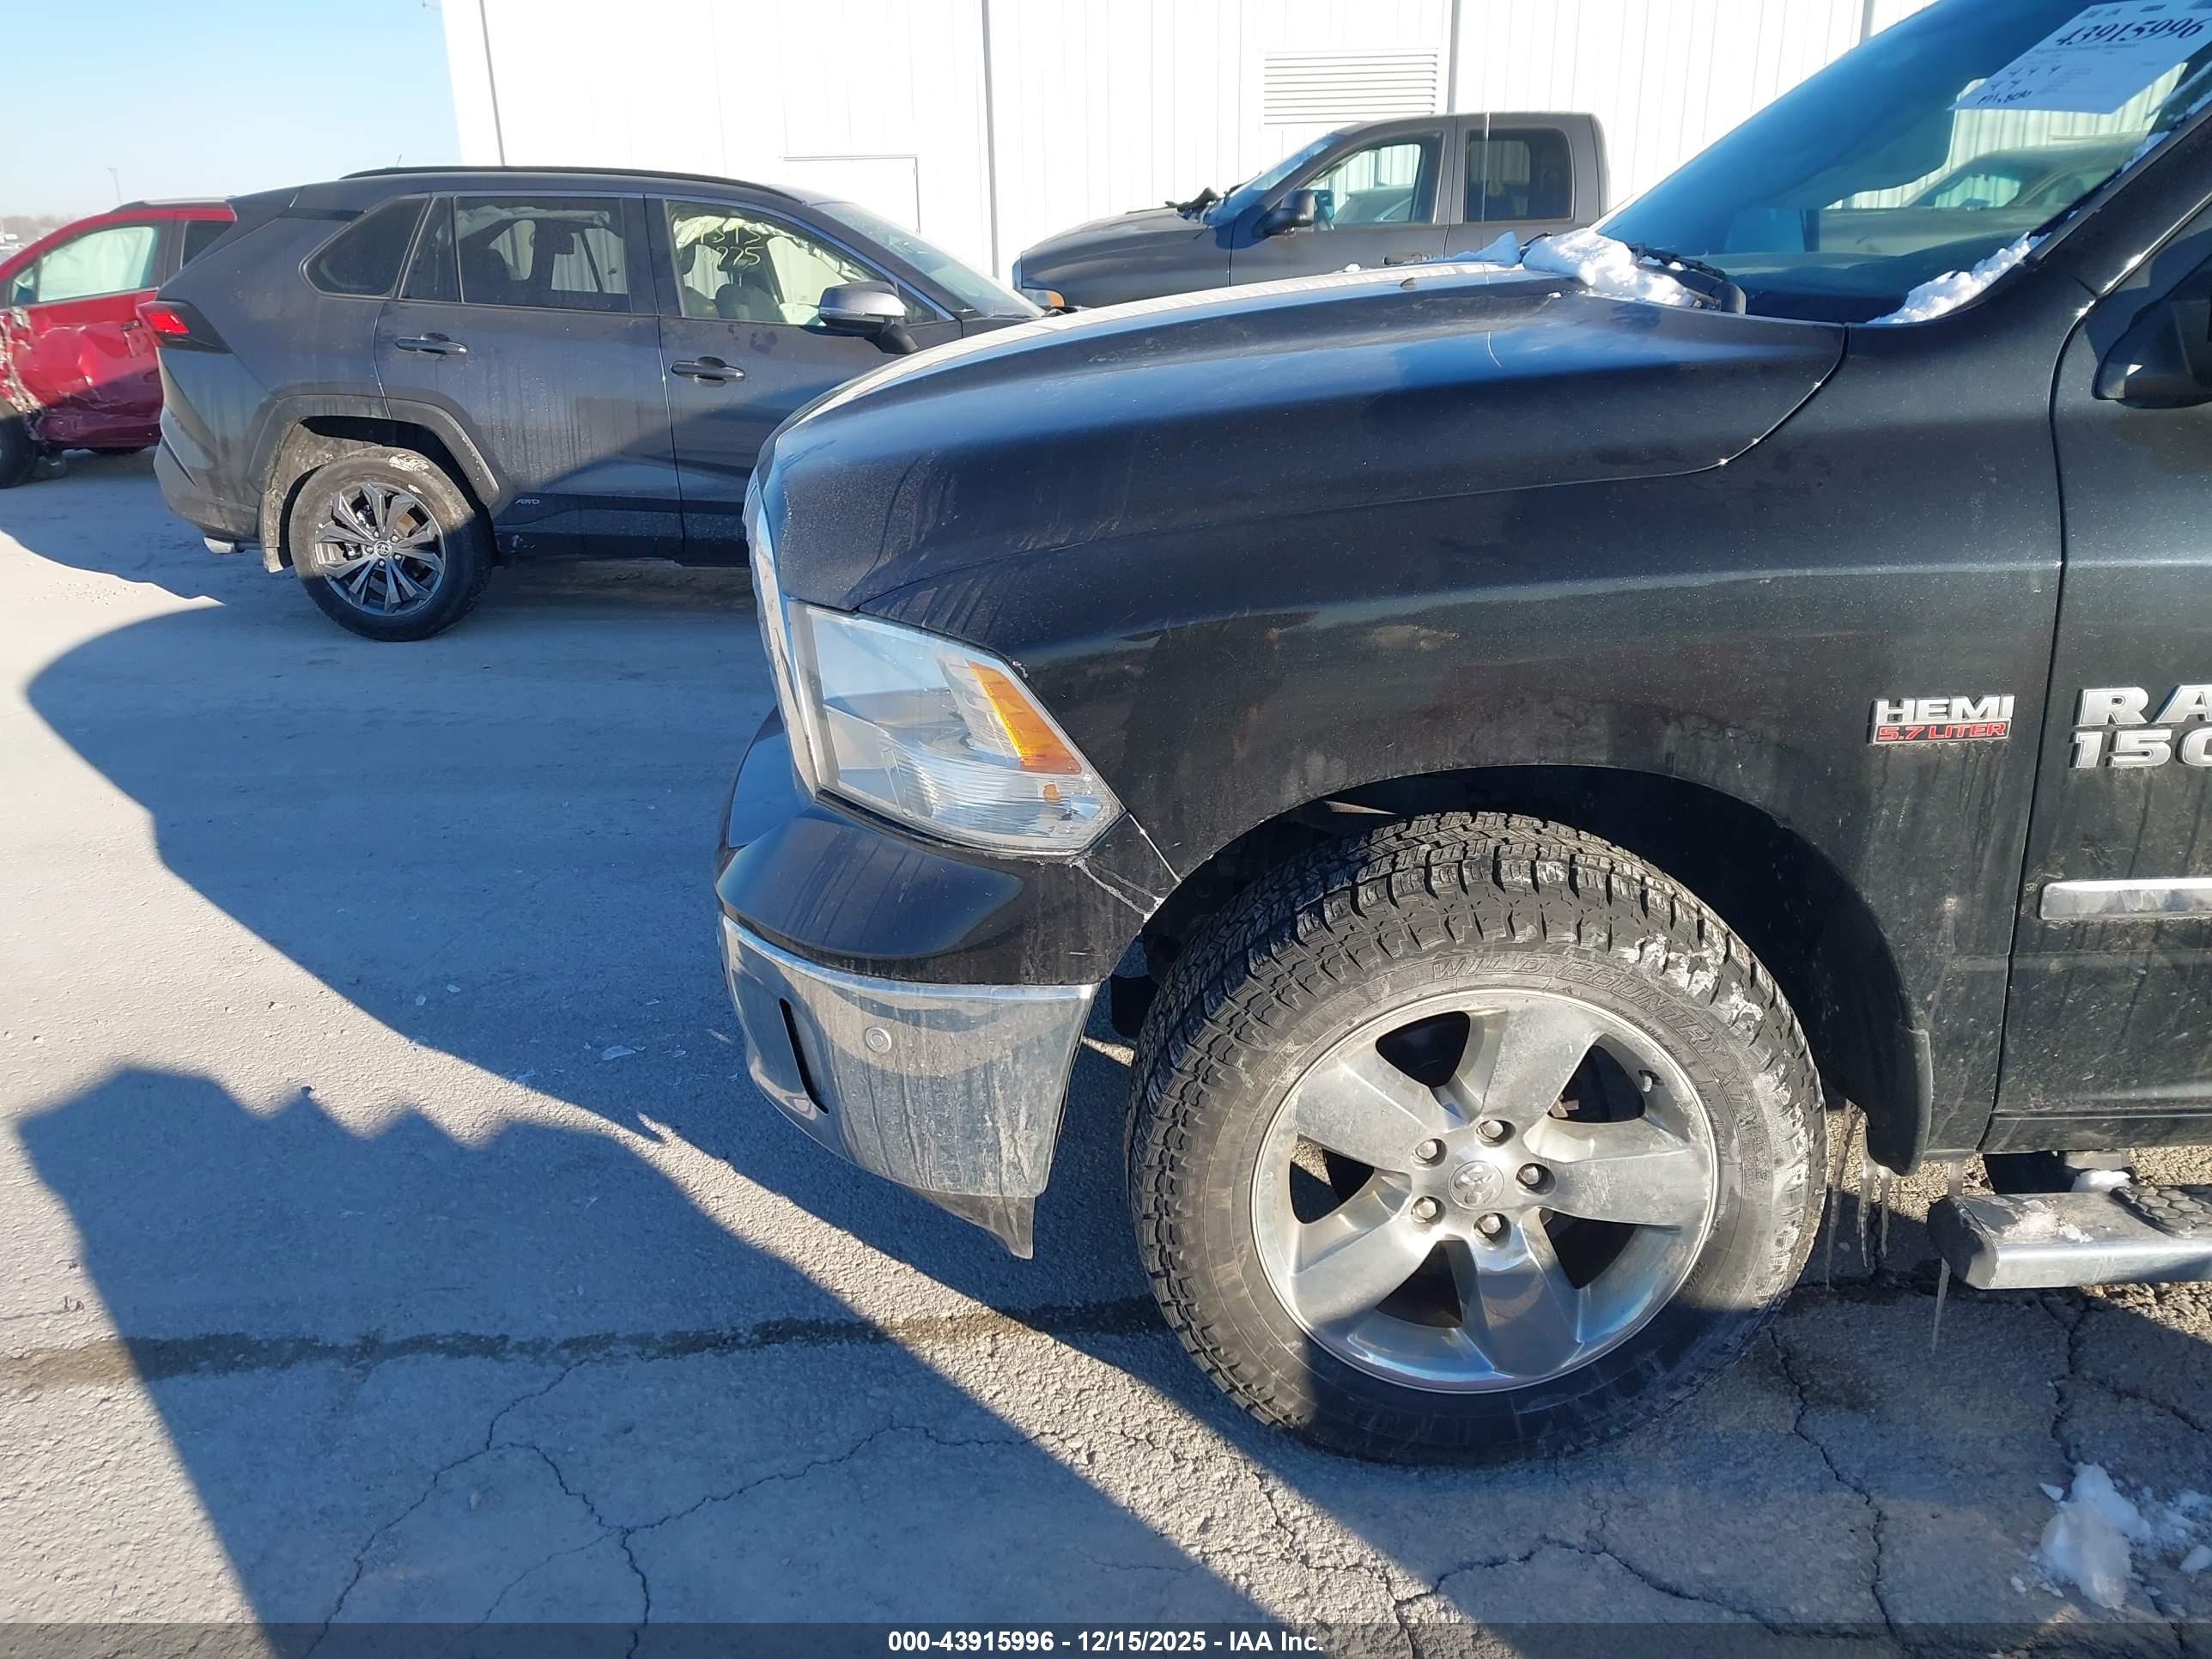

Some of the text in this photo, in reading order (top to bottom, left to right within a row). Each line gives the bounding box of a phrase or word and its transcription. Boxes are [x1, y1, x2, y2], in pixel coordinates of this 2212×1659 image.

[2056, 16, 2212, 46] 43915996
[1874, 694, 2015, 724] HEMI
[1878, 722, 2008, 742] 5.7 LITER
[1432, 957, 1547, 981] WILD
[1557, 958, 1732, 1066] COUNTRY
